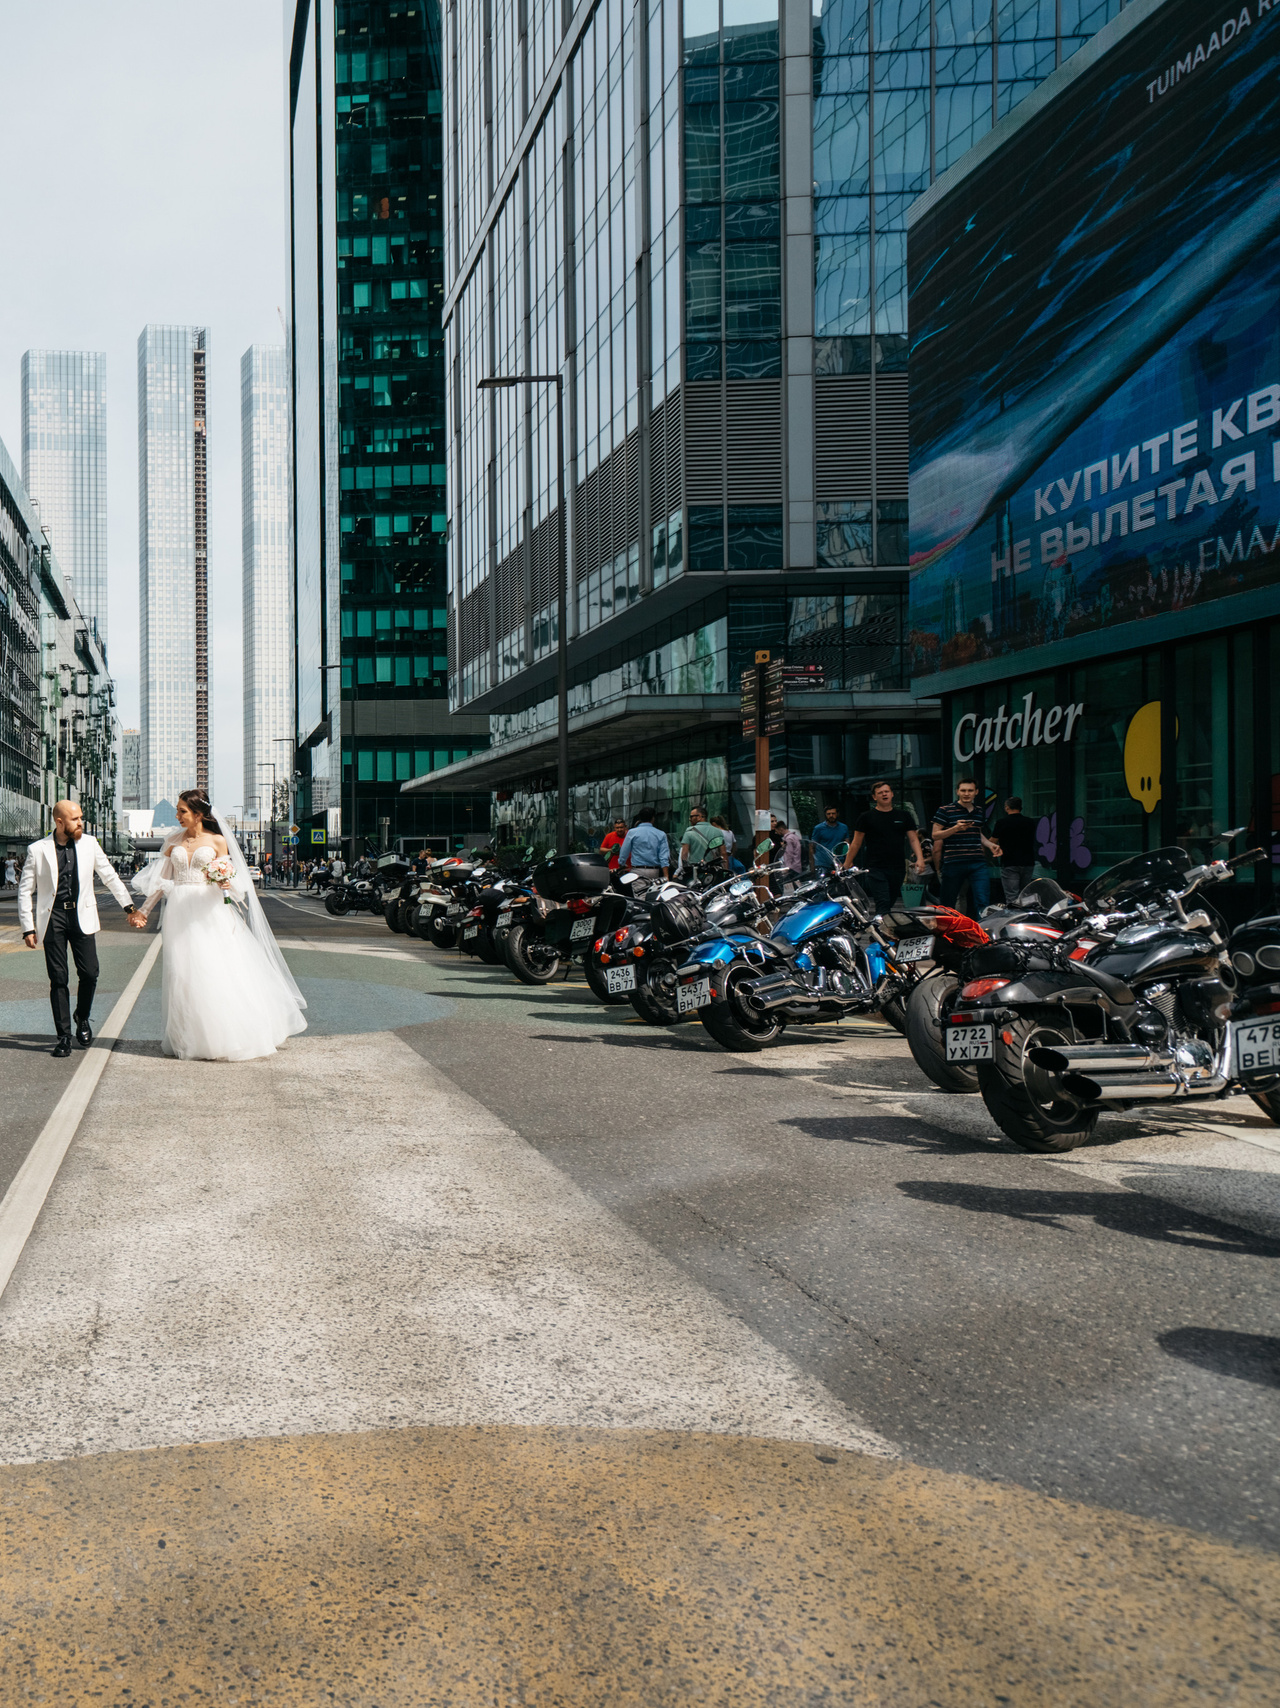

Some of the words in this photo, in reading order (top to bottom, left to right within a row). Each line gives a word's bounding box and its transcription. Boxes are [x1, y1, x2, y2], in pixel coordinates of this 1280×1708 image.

[1146, 7, 1251, 103] TUIMAADA
[1034, 418, 1198, 522] КУПИТЕ
[991, 537, 1032, 583] НЕ
[1040, 449, 1256, 565] ВЫЛЕТАЯ
[953, 691, 1084, 763] Catcher
[902, 936, 928, 947] 4582
[610, 967, 631, 980] 2436
[623, 979, 634, 989] 77
[681, 981, 704, 997] 5437
[695, 994, 707, 1006] 77
[952, 1027, 987, 1042] 2722
[1246, 1025, 1280, 1044] 478
[972, 1045, 989, 1058] 77
